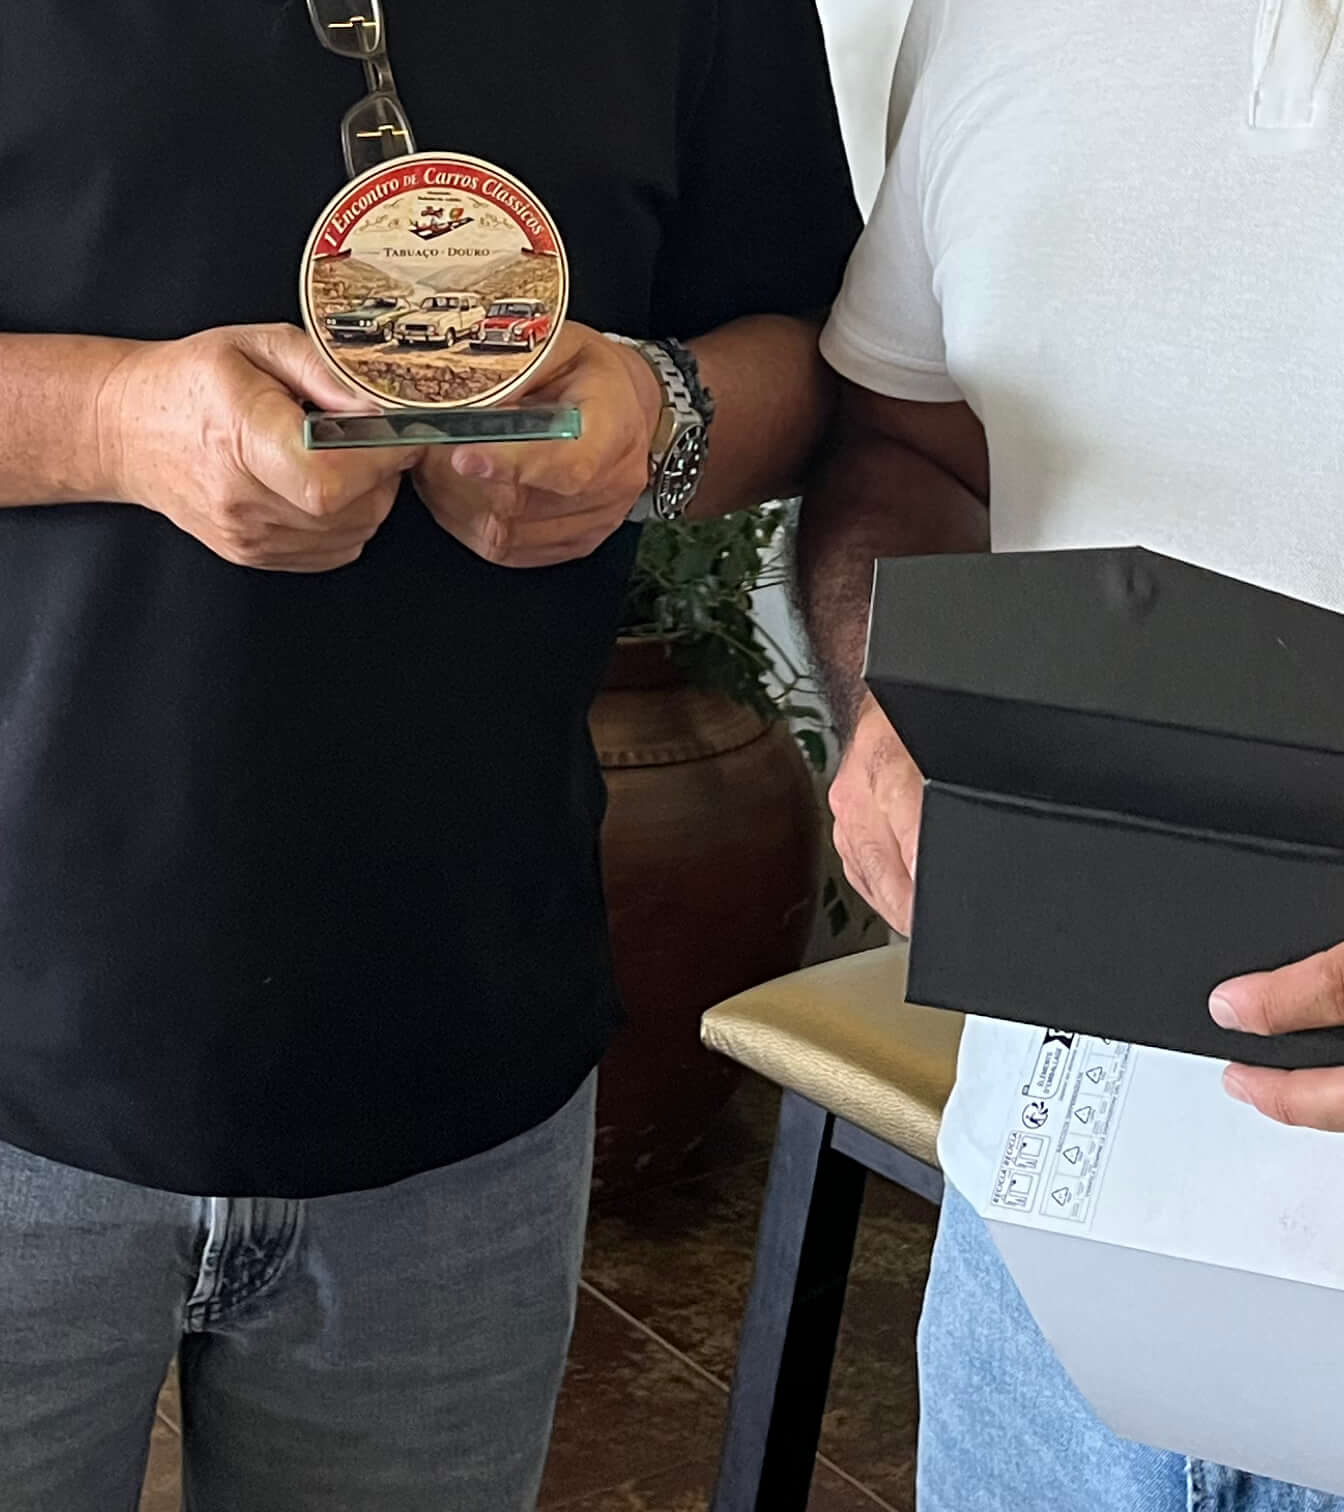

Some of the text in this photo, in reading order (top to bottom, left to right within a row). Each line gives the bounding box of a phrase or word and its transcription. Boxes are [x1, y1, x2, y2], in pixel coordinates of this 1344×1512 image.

[331, 178, 400, 234] Encontro
[403, 174, 419, 187] DE
[423, 167, 480, 190] Carros
[447, 248, 490, 257] DOURO
